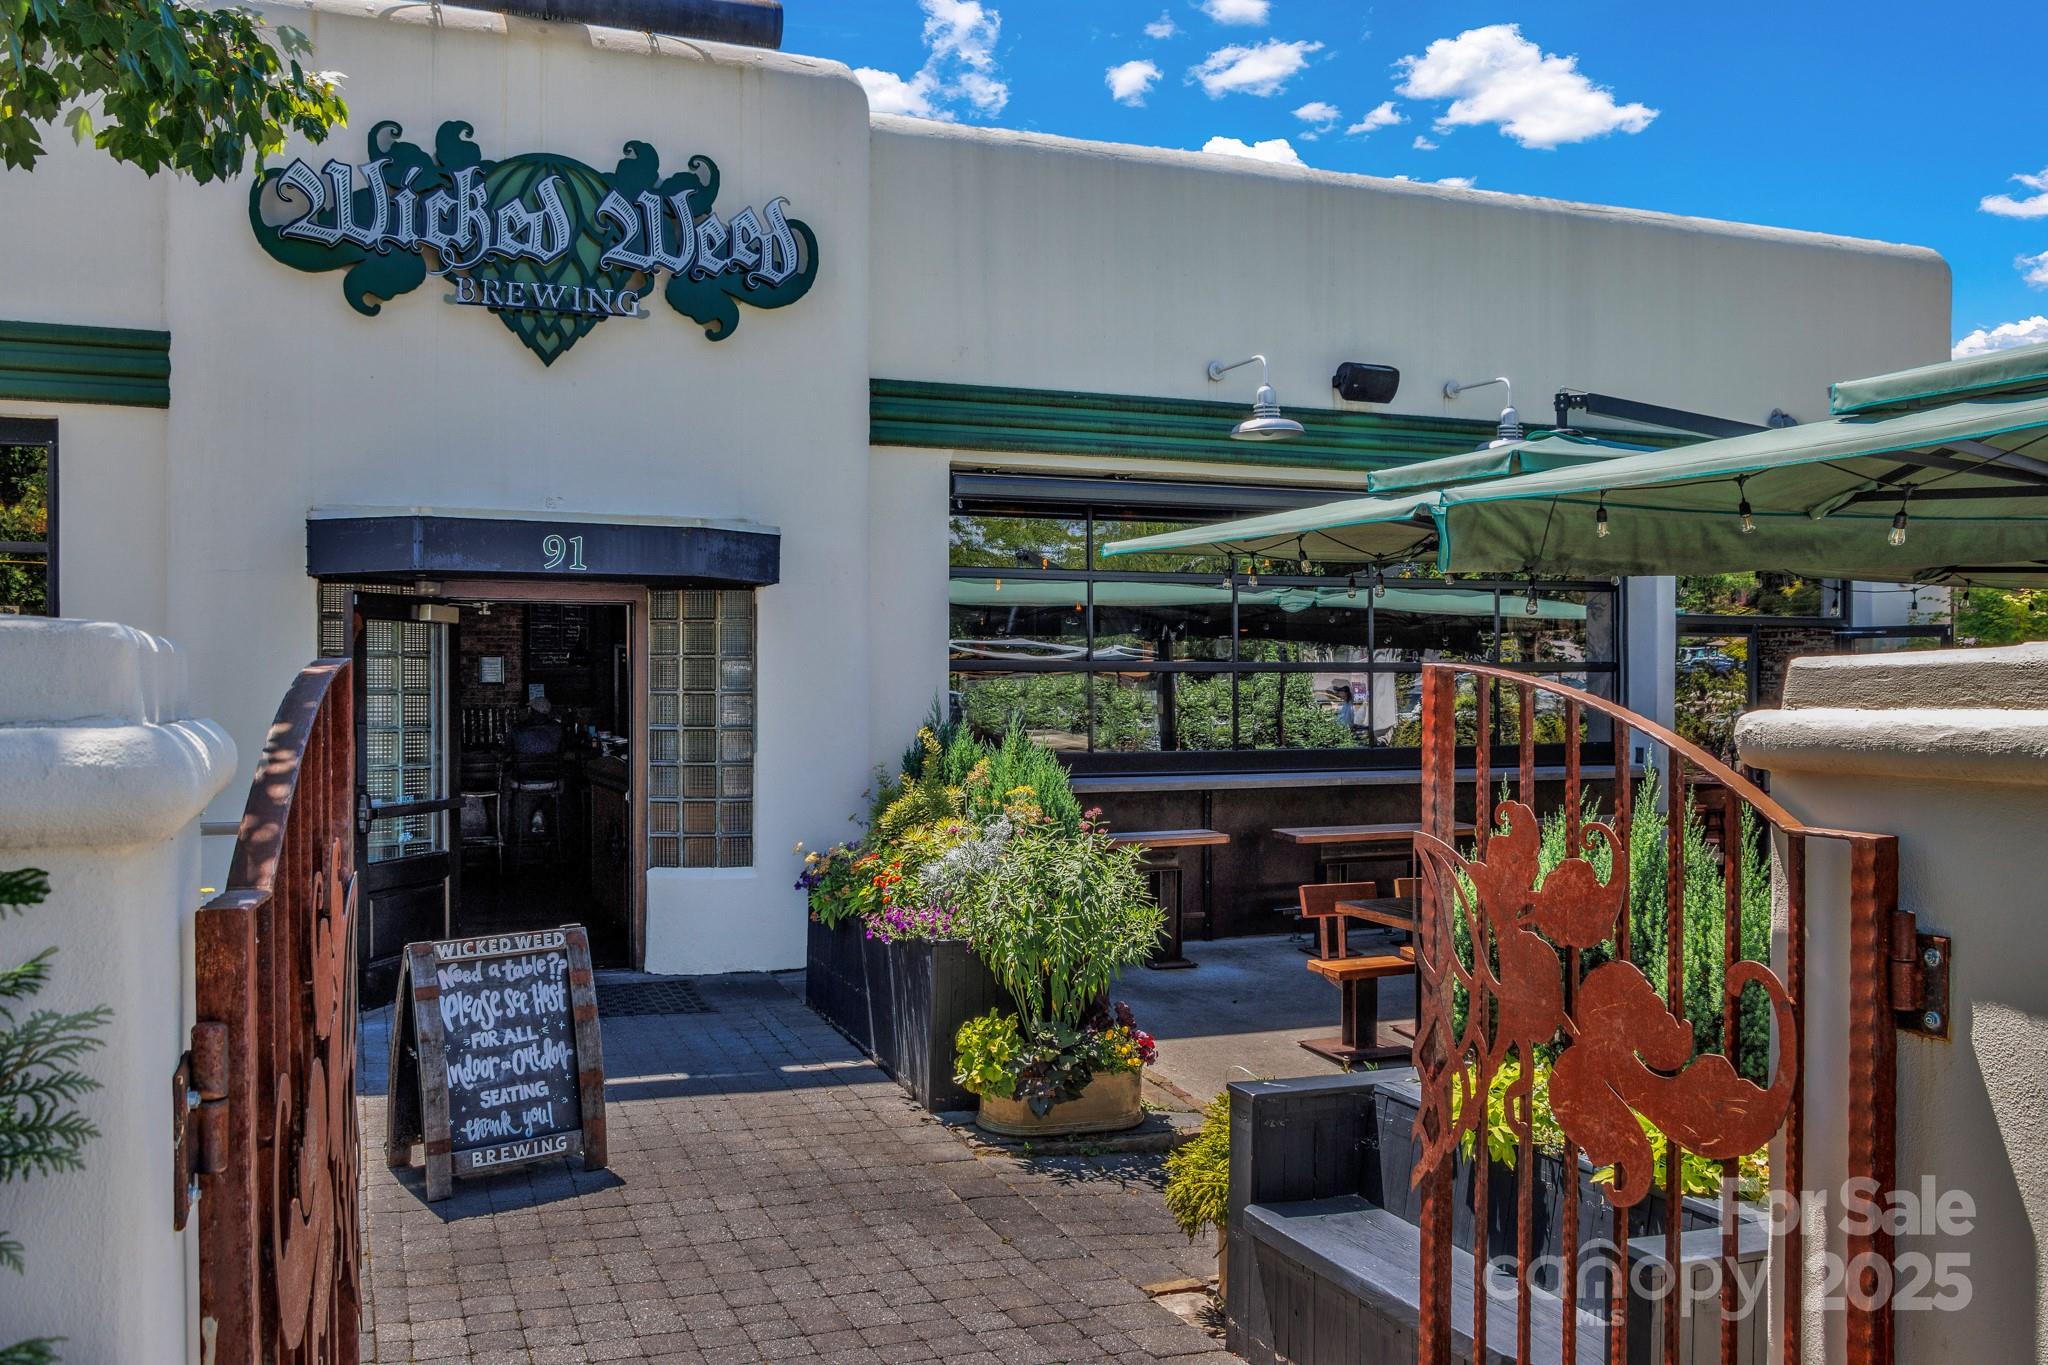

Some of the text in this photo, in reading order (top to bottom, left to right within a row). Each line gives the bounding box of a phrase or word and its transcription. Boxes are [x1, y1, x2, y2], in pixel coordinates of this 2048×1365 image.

[276, 156, 802, 291] Wicked Weed
[455, 276, 641, 316] BREWING
[542, 534, 588, 571] 91
[436, 931, 565, 960] WICKED WEED
[437, 961, 483, 990] Need
[488, 963, 501, 978] a
[530, 979, 567, 1015] Host
[470, 1025, 540, 1049] FOR ALL
[479, 1080, 549, 1108] SEATING
[460, 1101, 555, 1142] thank you!
[472, 1135, 567, 1168] BREWING
